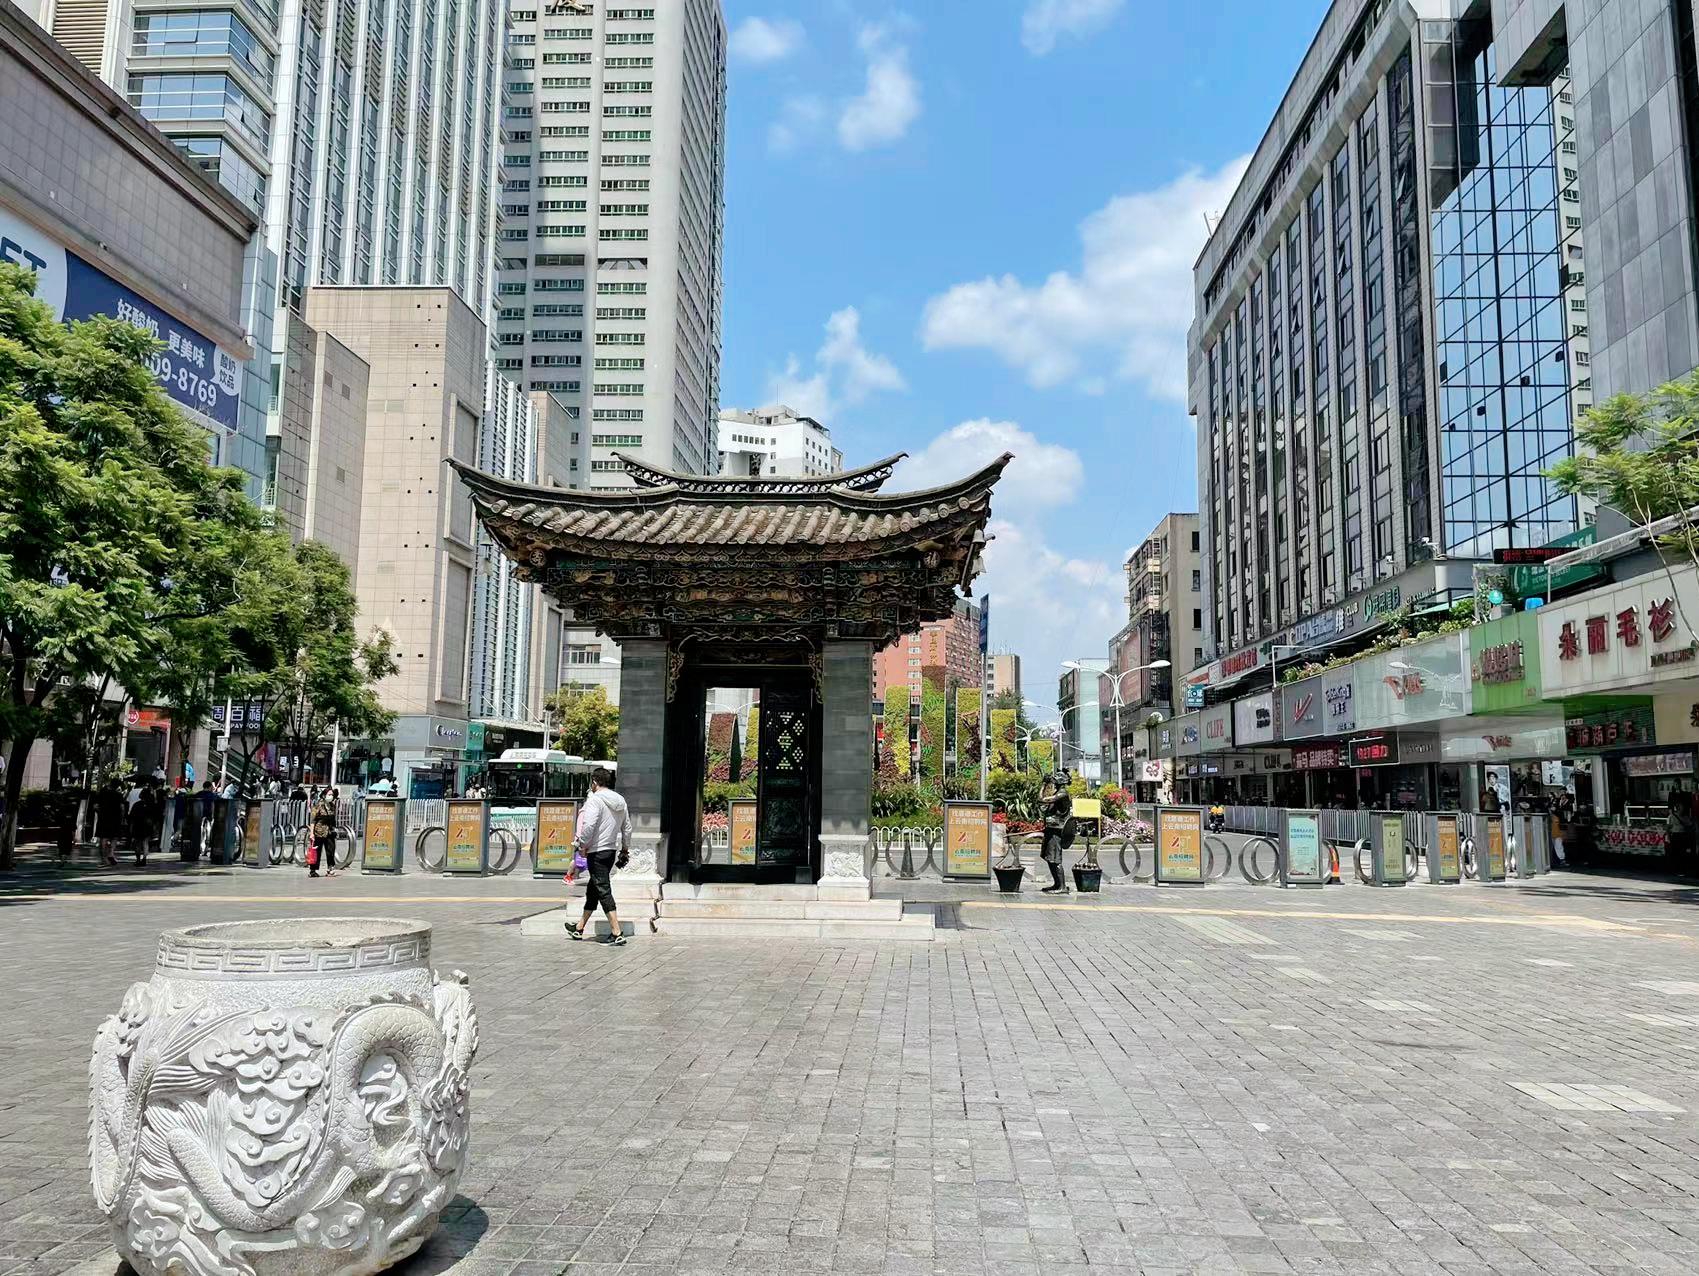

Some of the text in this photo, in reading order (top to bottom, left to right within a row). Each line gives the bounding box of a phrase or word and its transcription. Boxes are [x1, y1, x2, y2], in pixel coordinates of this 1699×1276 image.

[117, 298, 206, 369] 好酸奶 更美味
[145, 350, 217, 407] 09-8769
[218, 370, 235, 390] 饮品
[220, 352, 236, 373] 酸奶
